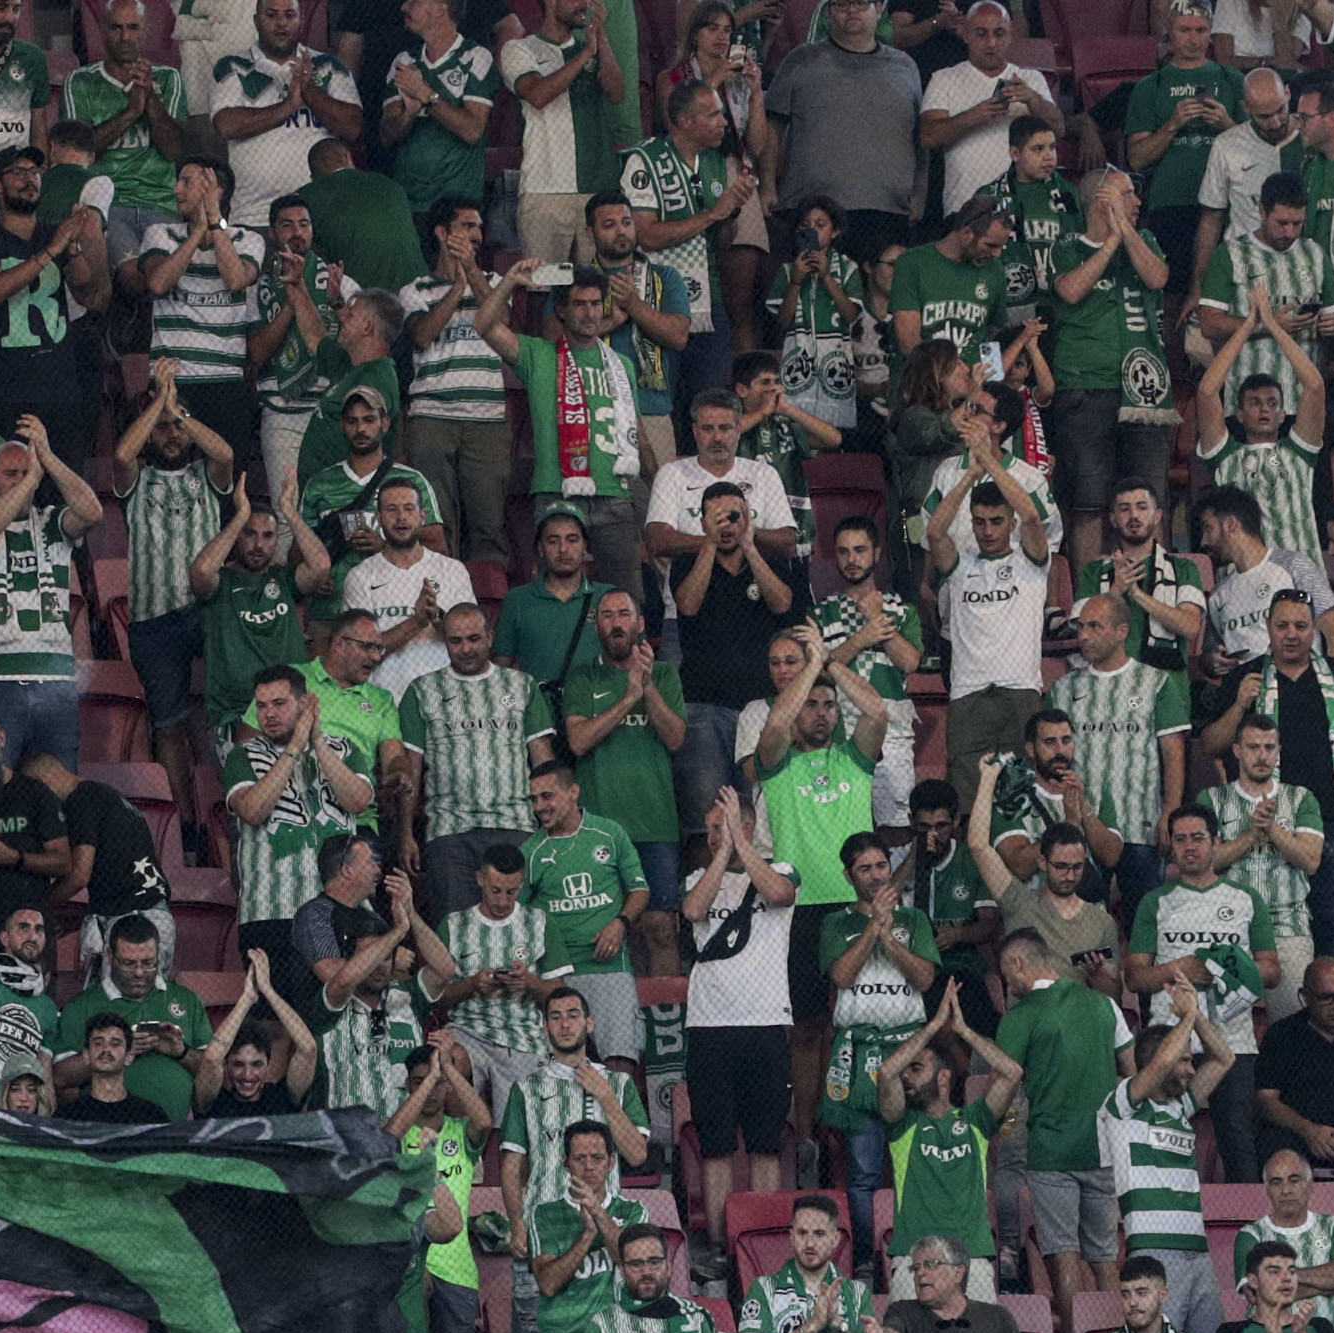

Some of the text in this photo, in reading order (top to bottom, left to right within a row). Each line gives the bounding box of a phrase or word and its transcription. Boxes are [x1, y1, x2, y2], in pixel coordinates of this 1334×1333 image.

[1, 257, 65, 347] R
[187, 292, 231, 306] BETANO
[443, 718, 518, 734] VOLVO
[548, 890, 614, 912] HONDA
[1163, 929, 1241, 946] VOLVO
[849, 982, 911, 998] VOLVO
